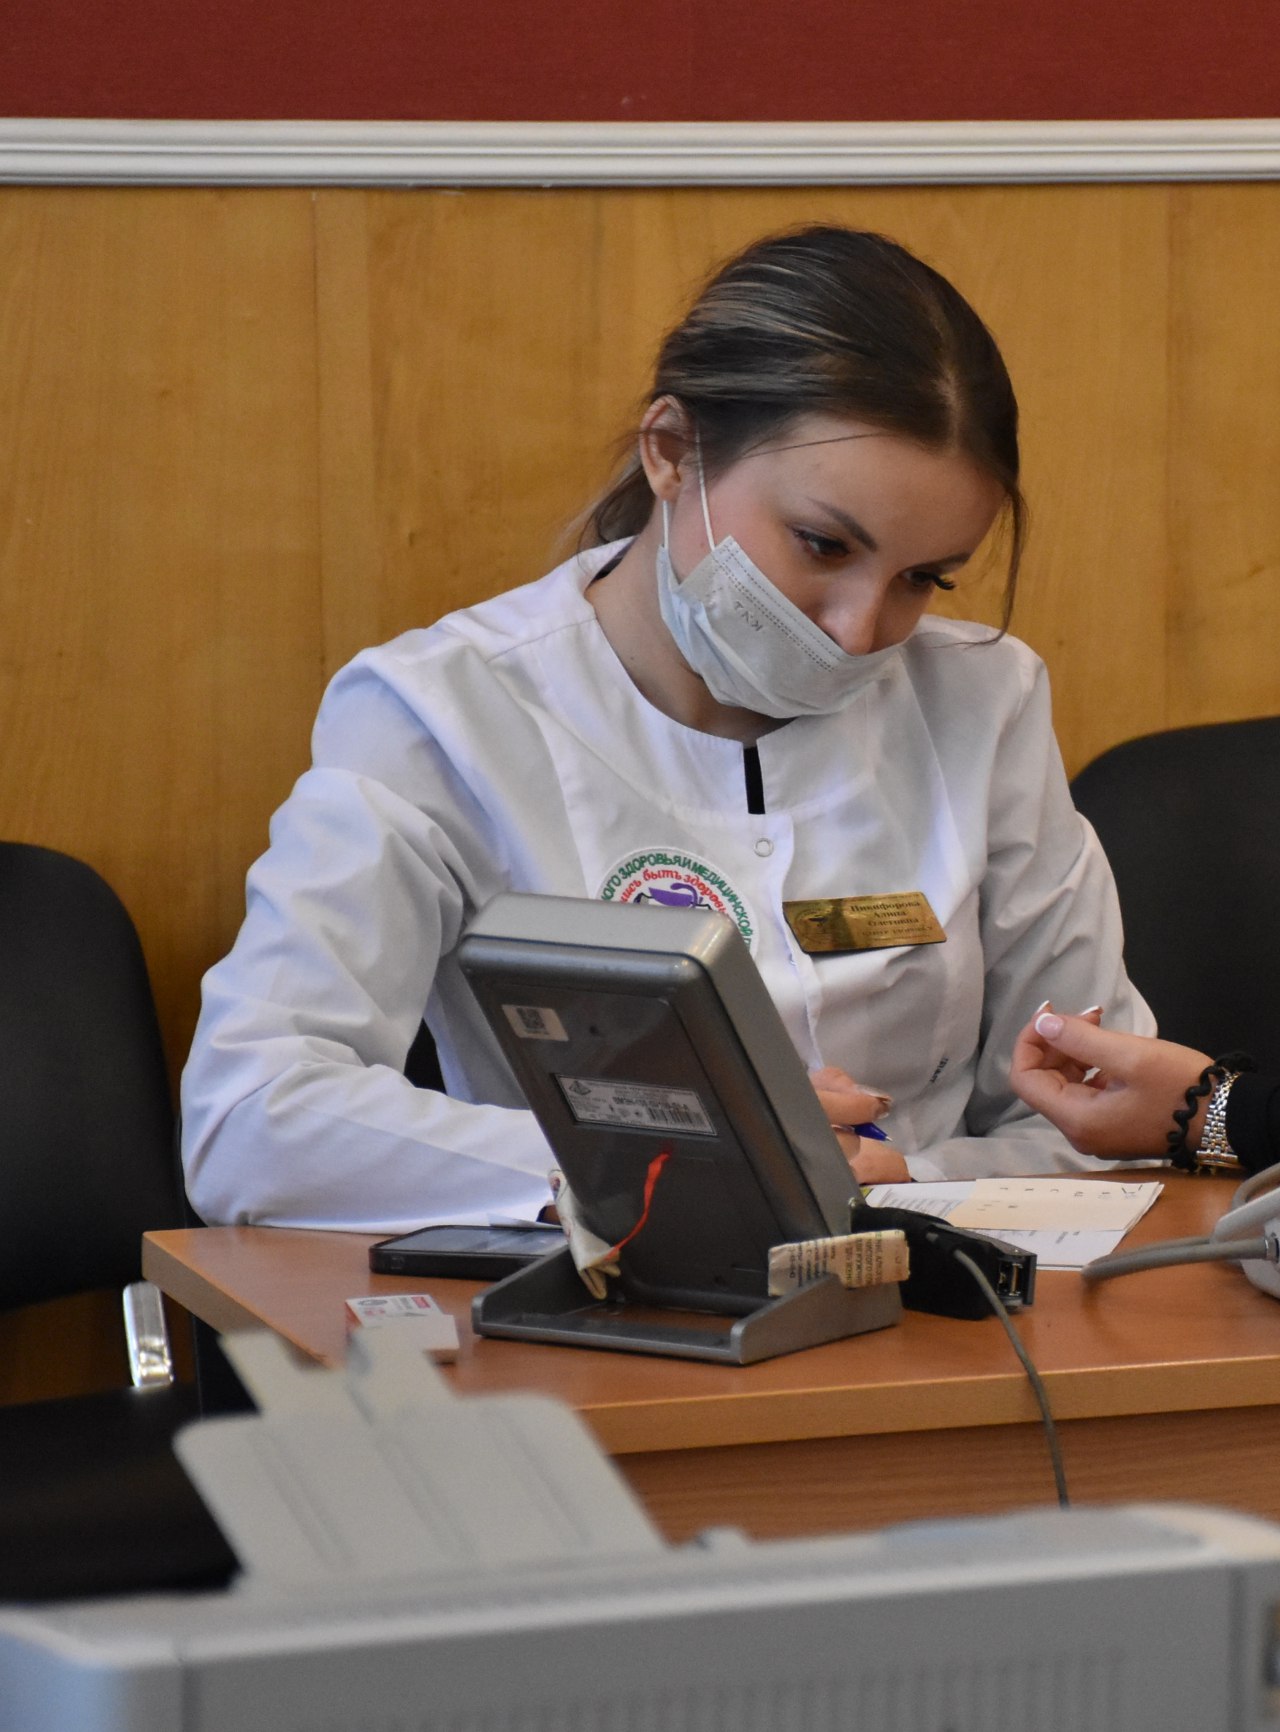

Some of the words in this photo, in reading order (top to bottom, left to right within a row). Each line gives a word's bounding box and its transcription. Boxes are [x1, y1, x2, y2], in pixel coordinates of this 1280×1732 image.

[619, 853, 682, 879] ЗДОРОВЬЯ
[691, 861, 753, 937] МЕДИЦИНСКОЙ
[643, 868, 682, 881] быть
